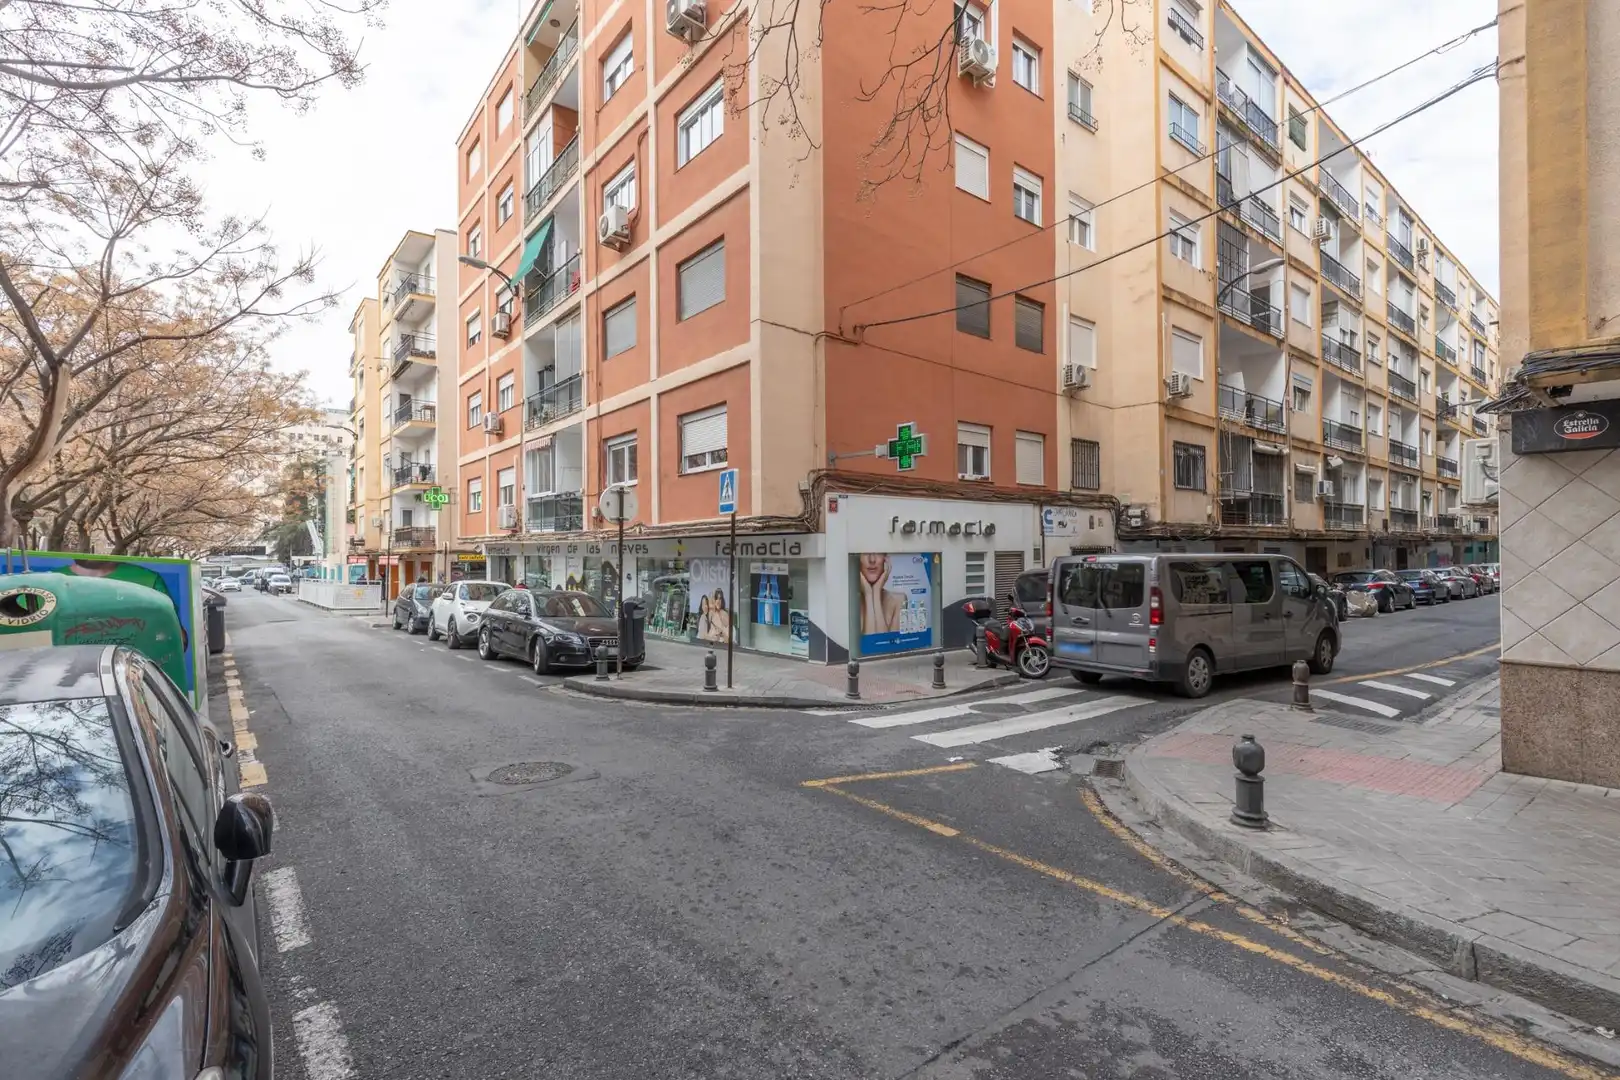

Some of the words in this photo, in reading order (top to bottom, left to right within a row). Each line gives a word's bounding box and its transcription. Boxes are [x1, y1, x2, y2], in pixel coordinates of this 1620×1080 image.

[1563, 418, 1599, 427] Estrella
[1564, 424, 1597, 433] Galicia
[890, 516, 996, 536] farmacia
[536, 544, 560, 555] virgen
[567, 543, 578, 554] de
[586, 543, 601, 554] las
[611, 543, 649, 555] neves
[715, 539, 802, 556] farmacia
[7, 609, 49, 625] VIDRIO
